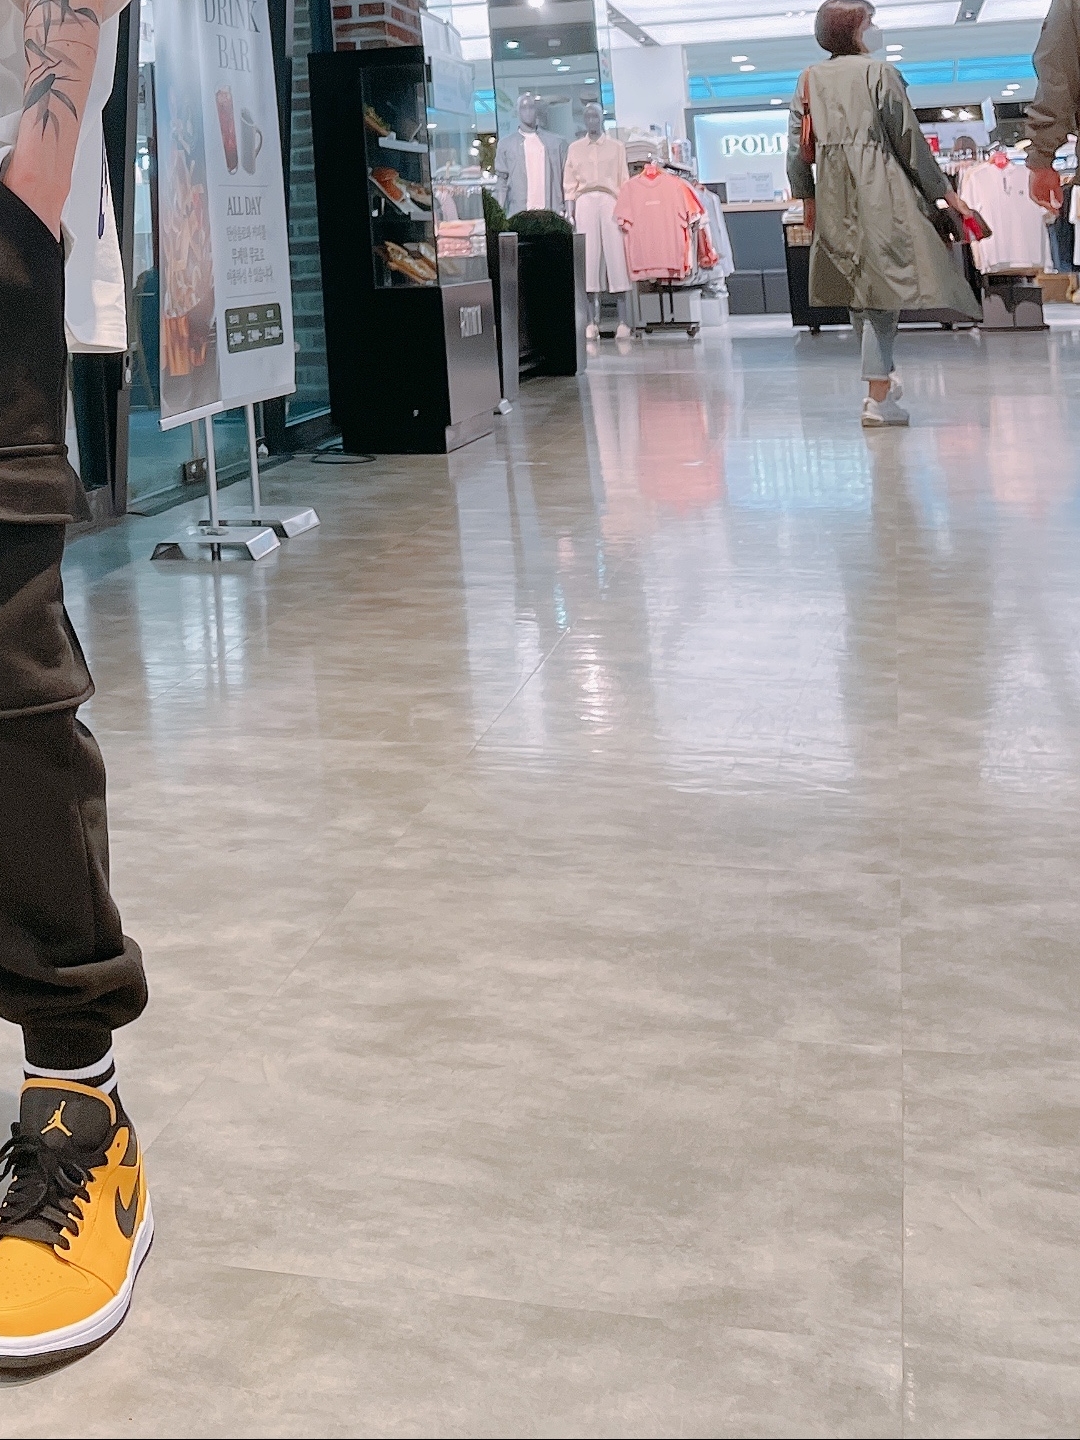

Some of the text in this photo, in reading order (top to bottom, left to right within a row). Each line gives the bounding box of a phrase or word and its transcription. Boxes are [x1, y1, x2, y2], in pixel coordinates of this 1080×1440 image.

[216, 34, 251, 73] BAR
[227, 196, 262, 216] ALL DAY
